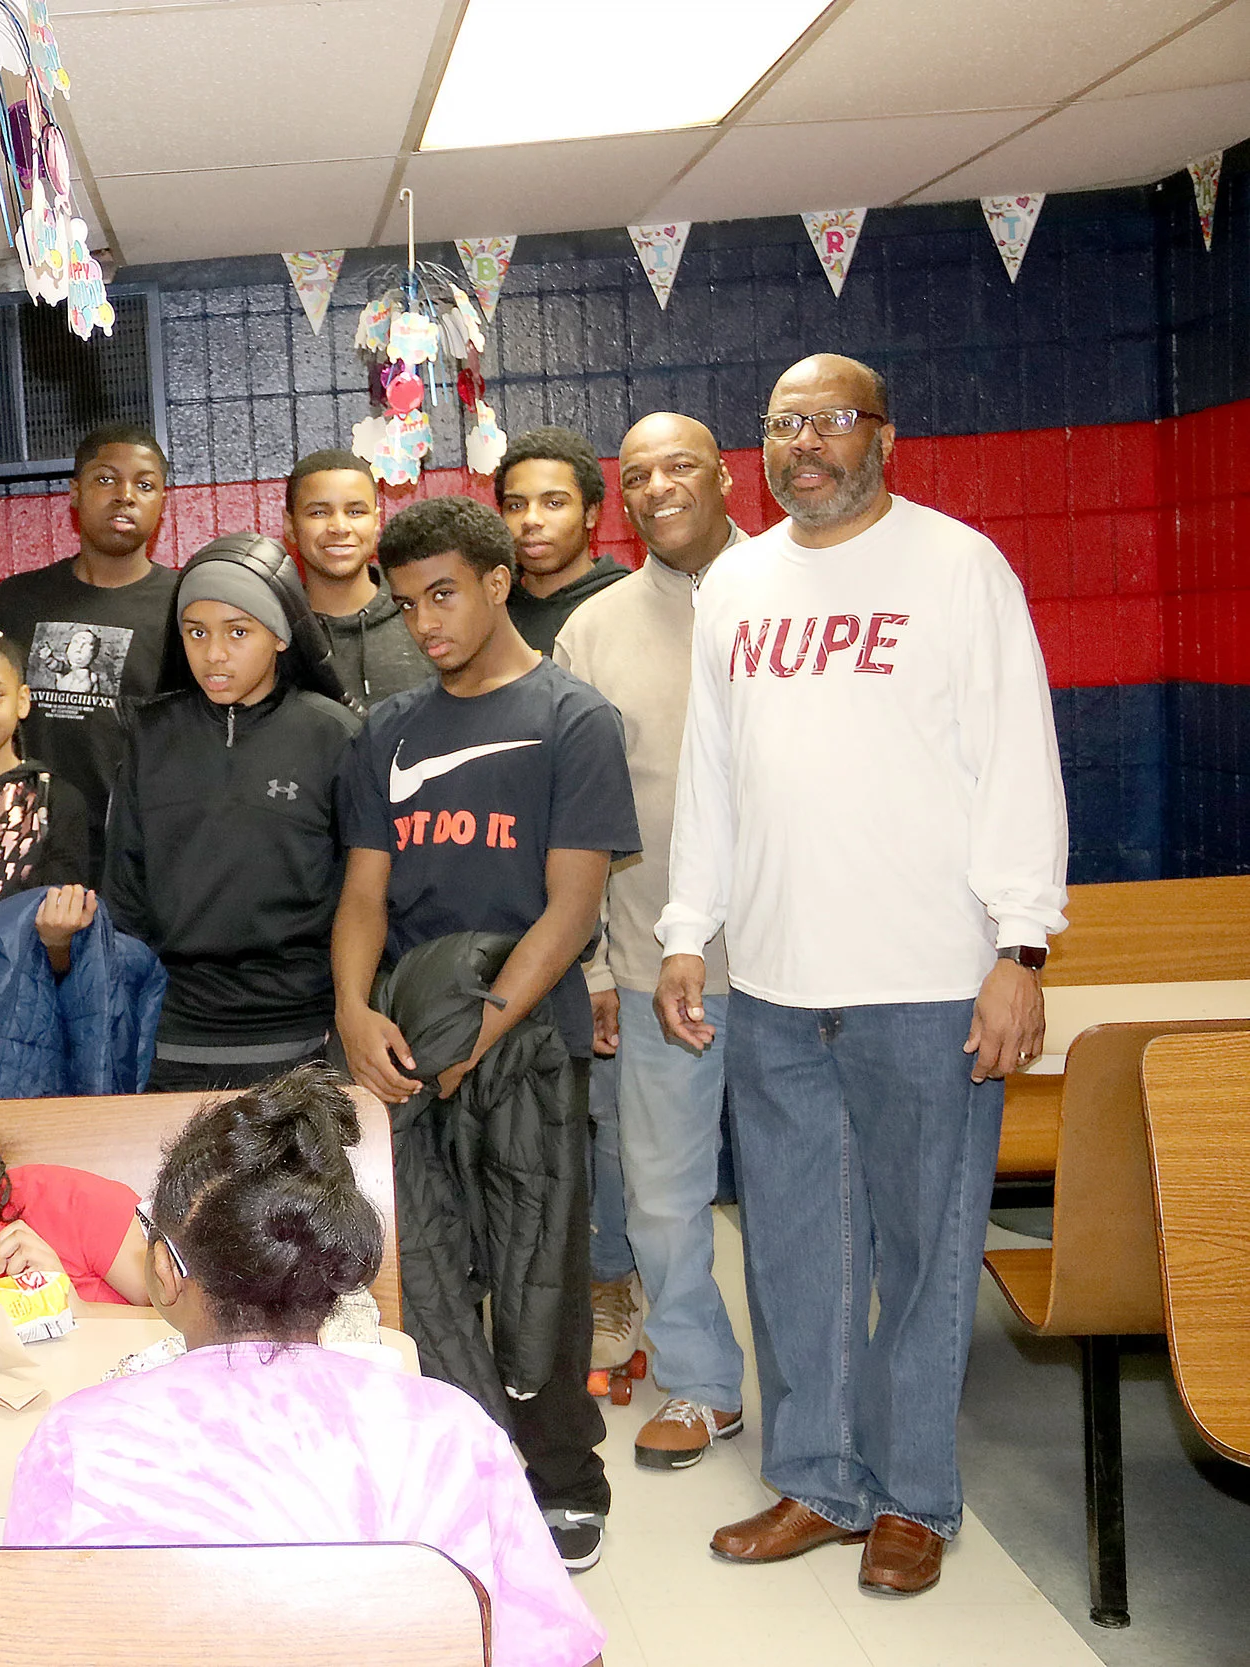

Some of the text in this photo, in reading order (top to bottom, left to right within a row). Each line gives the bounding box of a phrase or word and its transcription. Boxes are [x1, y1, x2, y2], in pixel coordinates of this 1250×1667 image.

[476, 257, 497, 281] B
[652, 244, 667, 268] I
[825, 231, 845, 254] R
[1001, 216, 1022, 240] T
[729, 612, 910, 682] NUPE
[433, 810, 477, 845] DO
